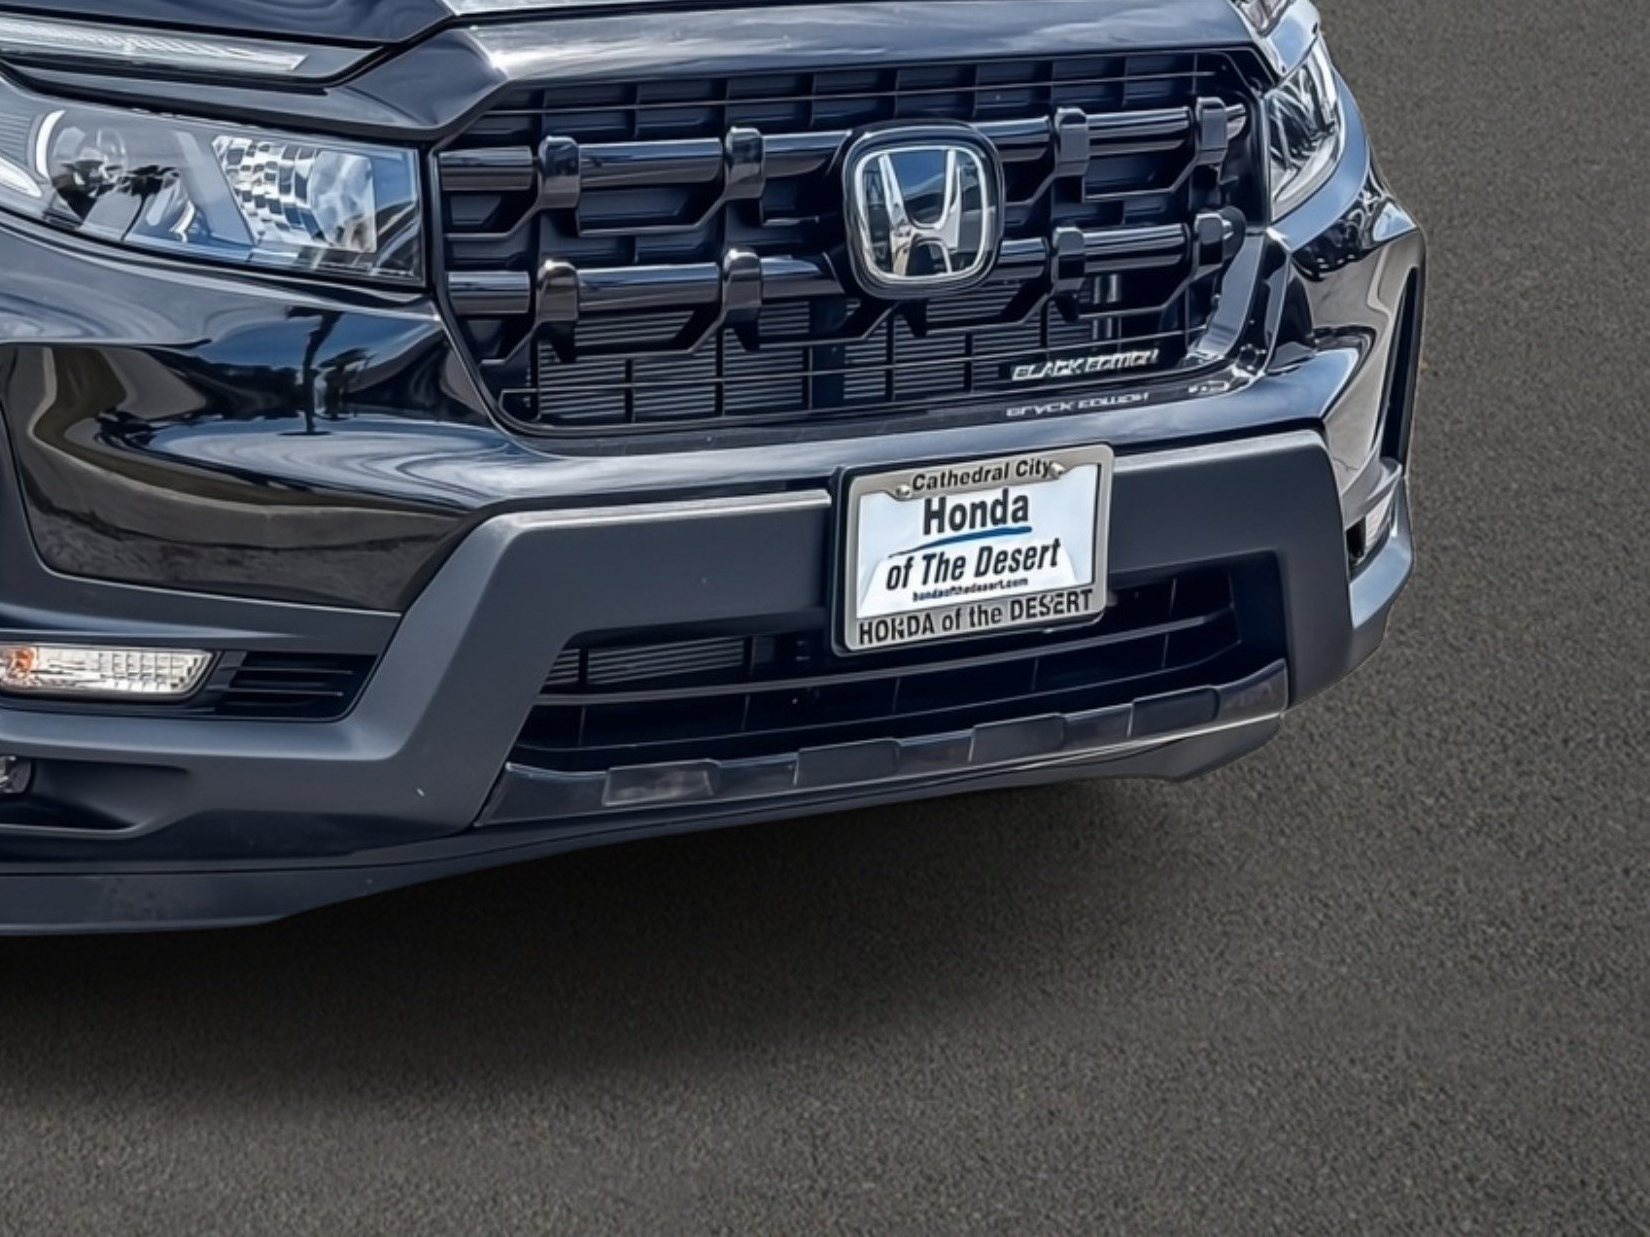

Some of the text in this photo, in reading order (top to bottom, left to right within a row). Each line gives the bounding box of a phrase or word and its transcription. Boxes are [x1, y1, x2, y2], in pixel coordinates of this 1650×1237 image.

[912, 459, 1053, 491] Cathedral City
[922, 488, 1030, 535] Honda
[886, 537, 1061, 591] of The Desert
[858, 588, 1093, 645] HONDA of the DESERT
